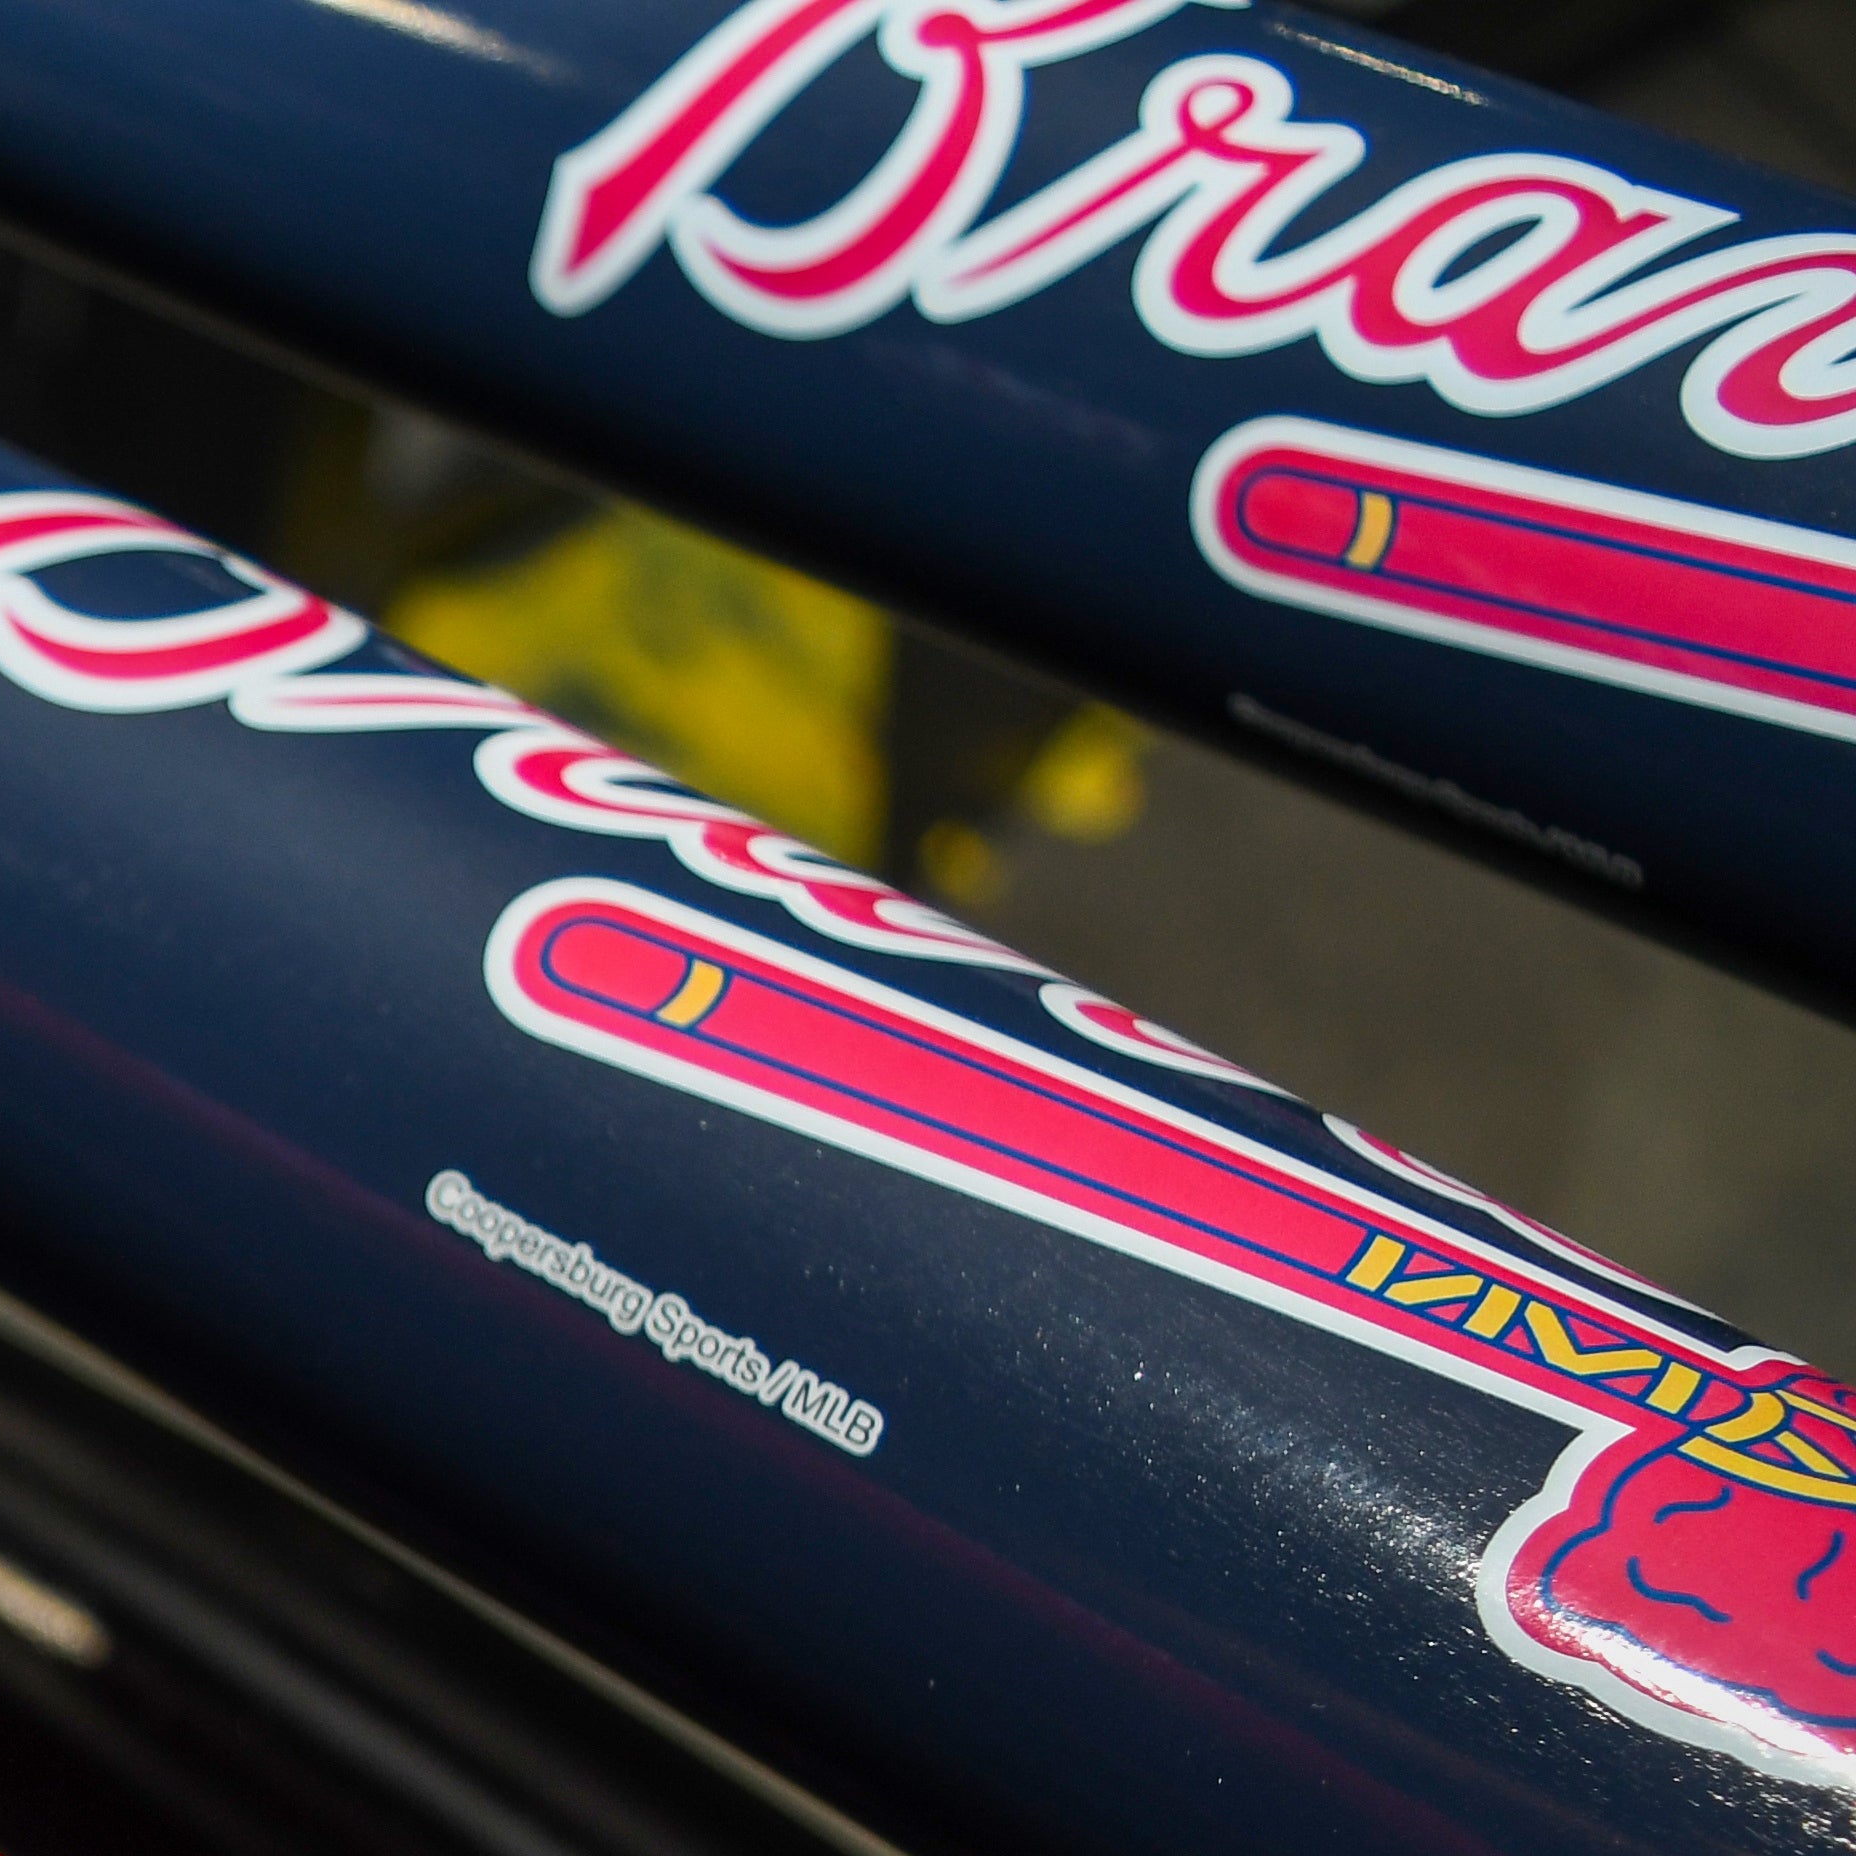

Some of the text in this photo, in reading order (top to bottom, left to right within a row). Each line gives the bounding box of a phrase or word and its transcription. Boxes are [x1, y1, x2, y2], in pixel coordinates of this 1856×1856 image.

[428, 1172, 648, 1331] Coopersburg
[647, 1297, 766, 1388] Sports
[790, 1376, 880, 1453] MLB
